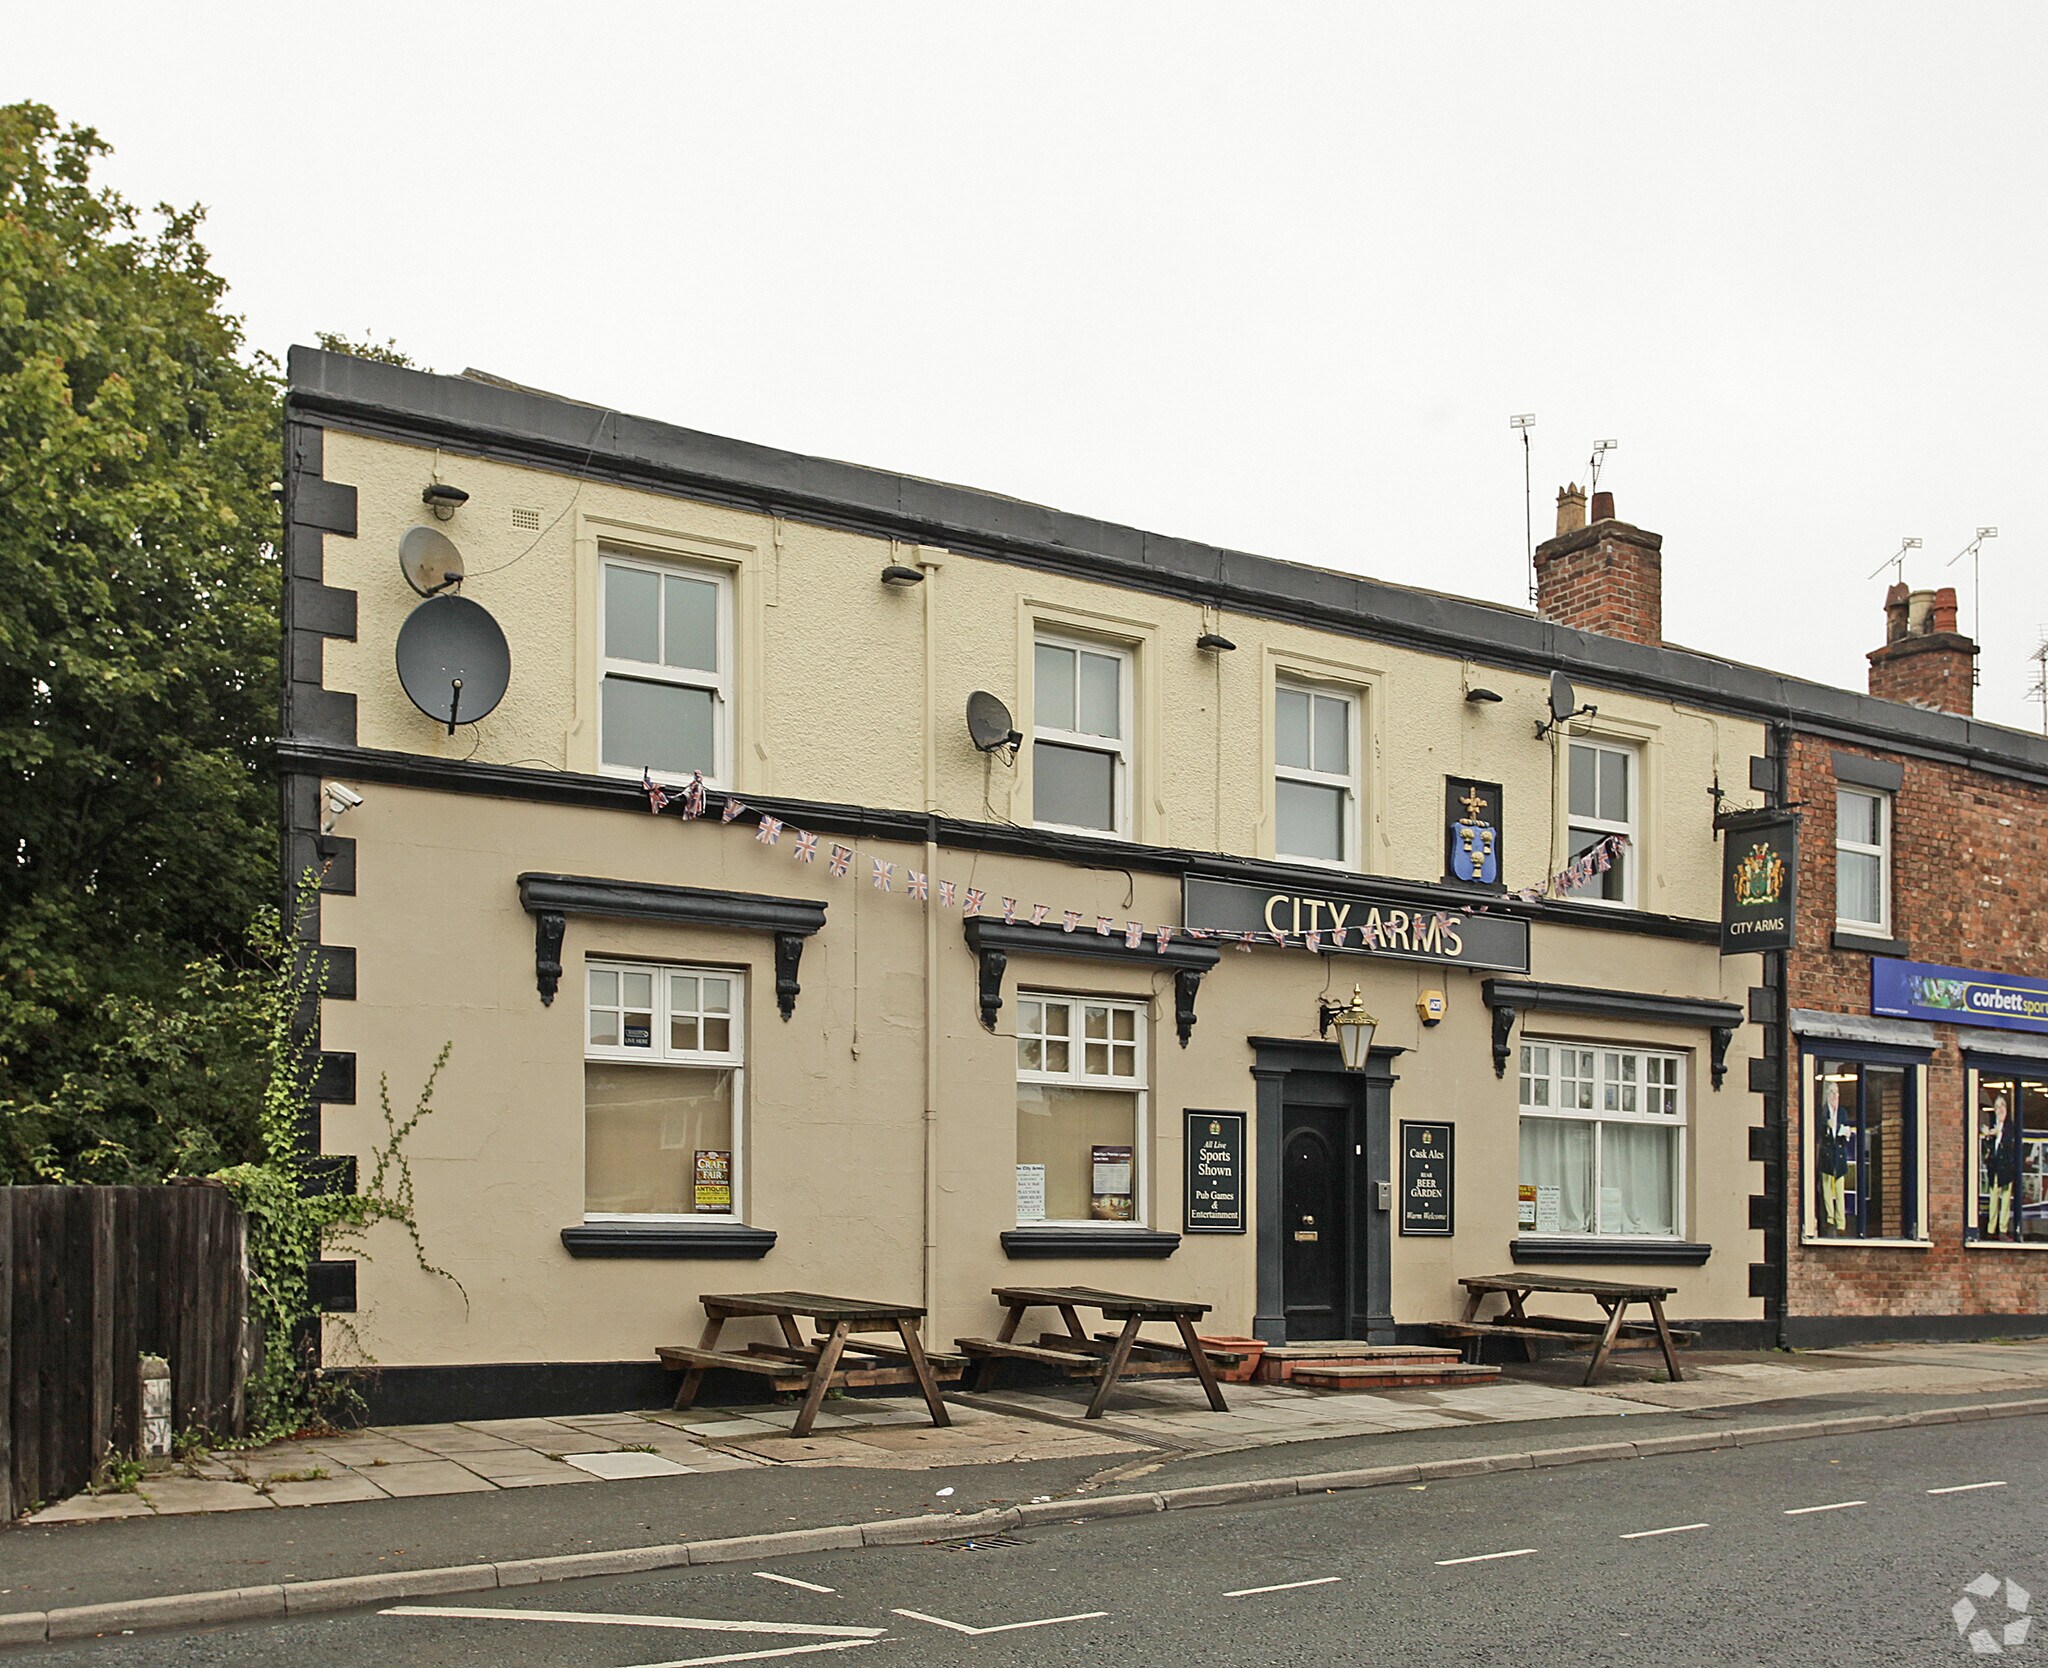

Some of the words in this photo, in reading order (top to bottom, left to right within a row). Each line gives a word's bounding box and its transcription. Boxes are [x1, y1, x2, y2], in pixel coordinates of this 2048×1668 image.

[1264, 894, 1351, 938] CITY
[1361, 907, 1463, 957] ARMS
[1730, 921, 1754, 935] CITY
[1755, 917, 1784, 933] ARMS
[1204, 1141, 1213, 1149] All
[1213, 1141, 1227, 1149] Live
[1200, 1148, 1231, 1164] Sports
[1409, 1148, 1427, 1159] Cask
[1428, 1149, 1444, 1160] Ales
[697, 1158, 728, 1169] CRAFT
[702, 1170, 722, 1180] FAIR
[1198, 1163, 1232, 1177] Shown
[1416, 1179, 1436, 1188] BEER
[1196, 1190, 1209, 1199] Pub
[1210, 1191, 1234, 1201] Games
[1410, 1187, 1442, 1198] GARDEN
[1211, 1201, 1218, 1210] &
[1191, 1209, 1238, 1219] Entertainment
[1406, 1211, 1422, 1219] Warm
[1423, 1212, 1447, 1220] Welcome
